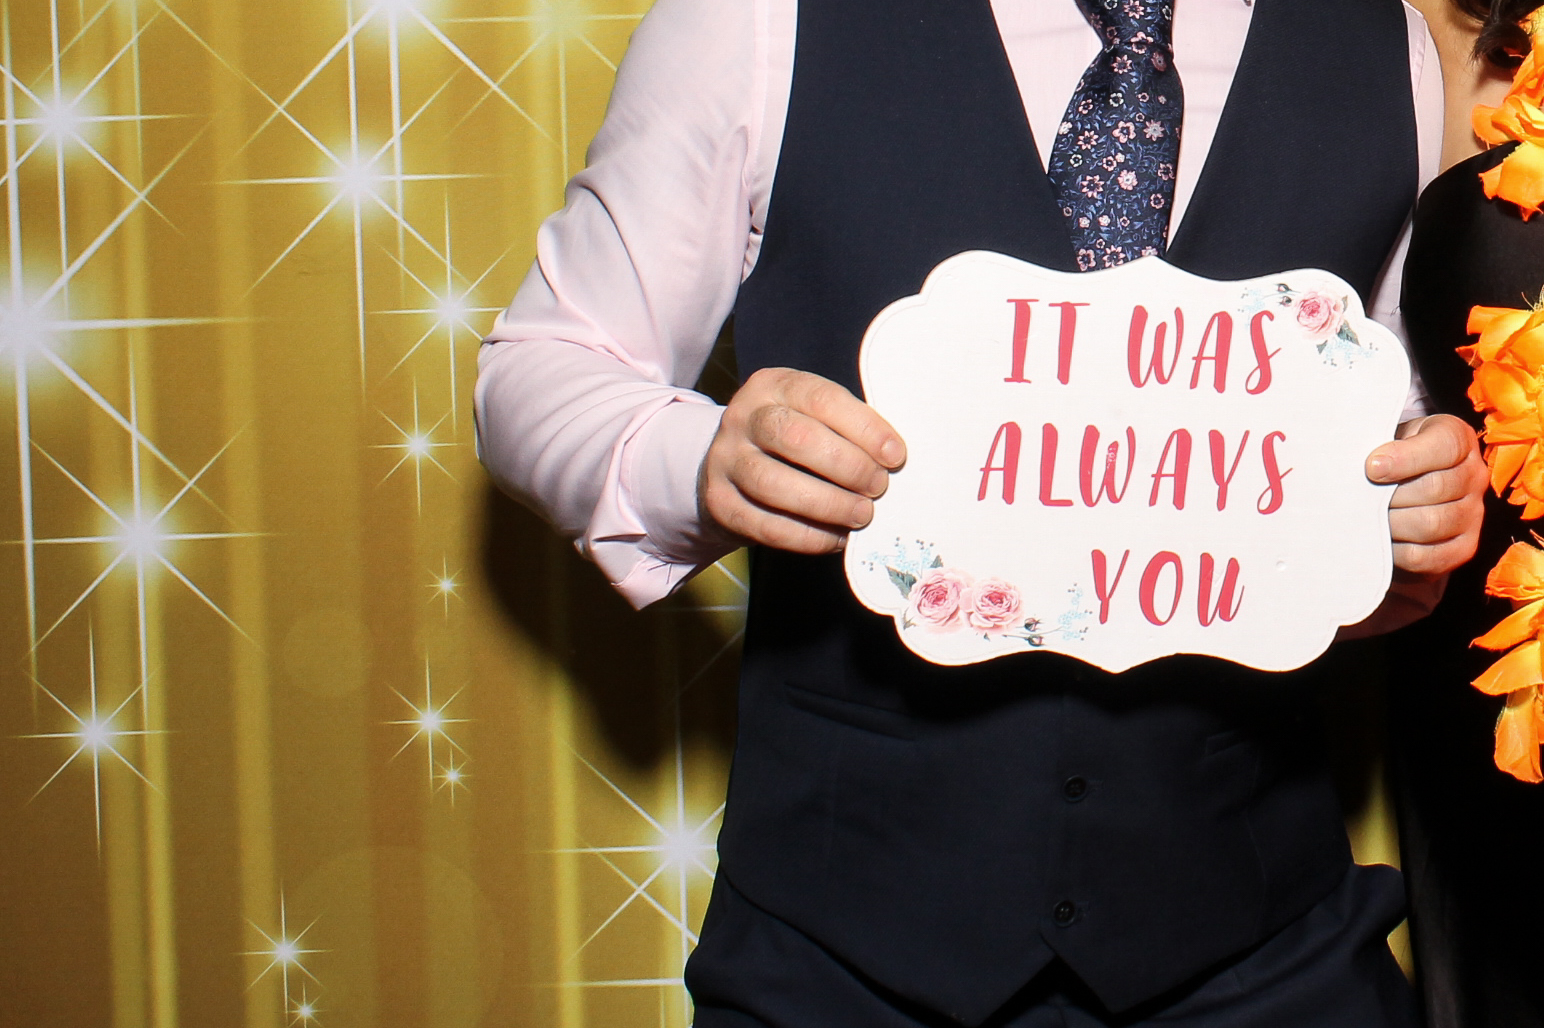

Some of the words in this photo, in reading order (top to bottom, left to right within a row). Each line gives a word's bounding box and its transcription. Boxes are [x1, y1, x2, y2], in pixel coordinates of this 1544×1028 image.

[1004, 298, 1091, 385] IT
[1127, 304, 1283, 395] WAS
[977, 421, 1294, 516] ALWAYS
[1091, 548, 1245, 628] YOU
